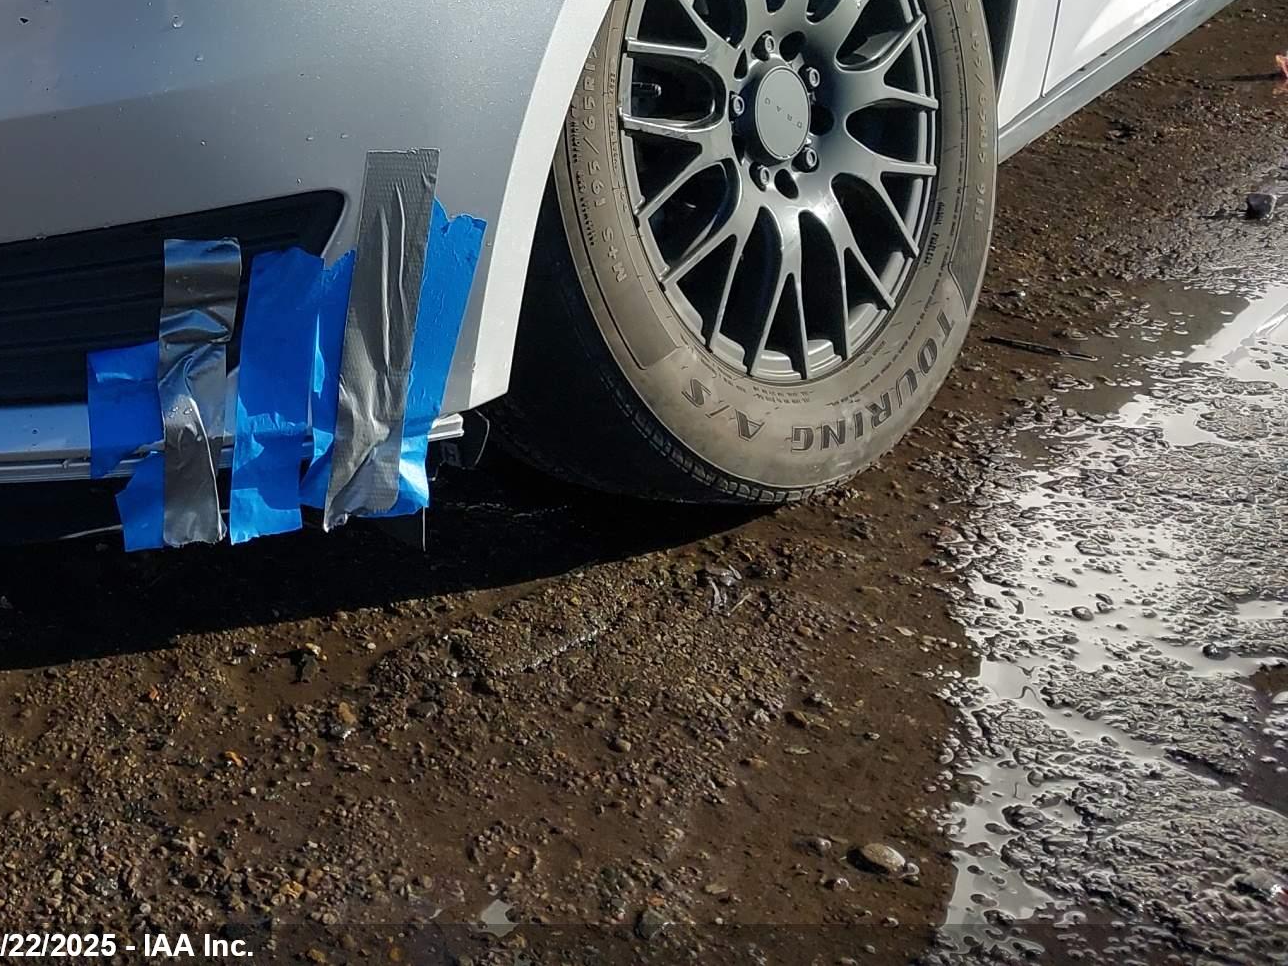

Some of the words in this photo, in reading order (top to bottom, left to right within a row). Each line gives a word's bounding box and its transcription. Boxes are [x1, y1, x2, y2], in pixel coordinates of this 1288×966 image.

[601, 225, 626, 285] M+S
[681, 377, 765, 442] A/S
[790, 307, 956, 453] TOURING
